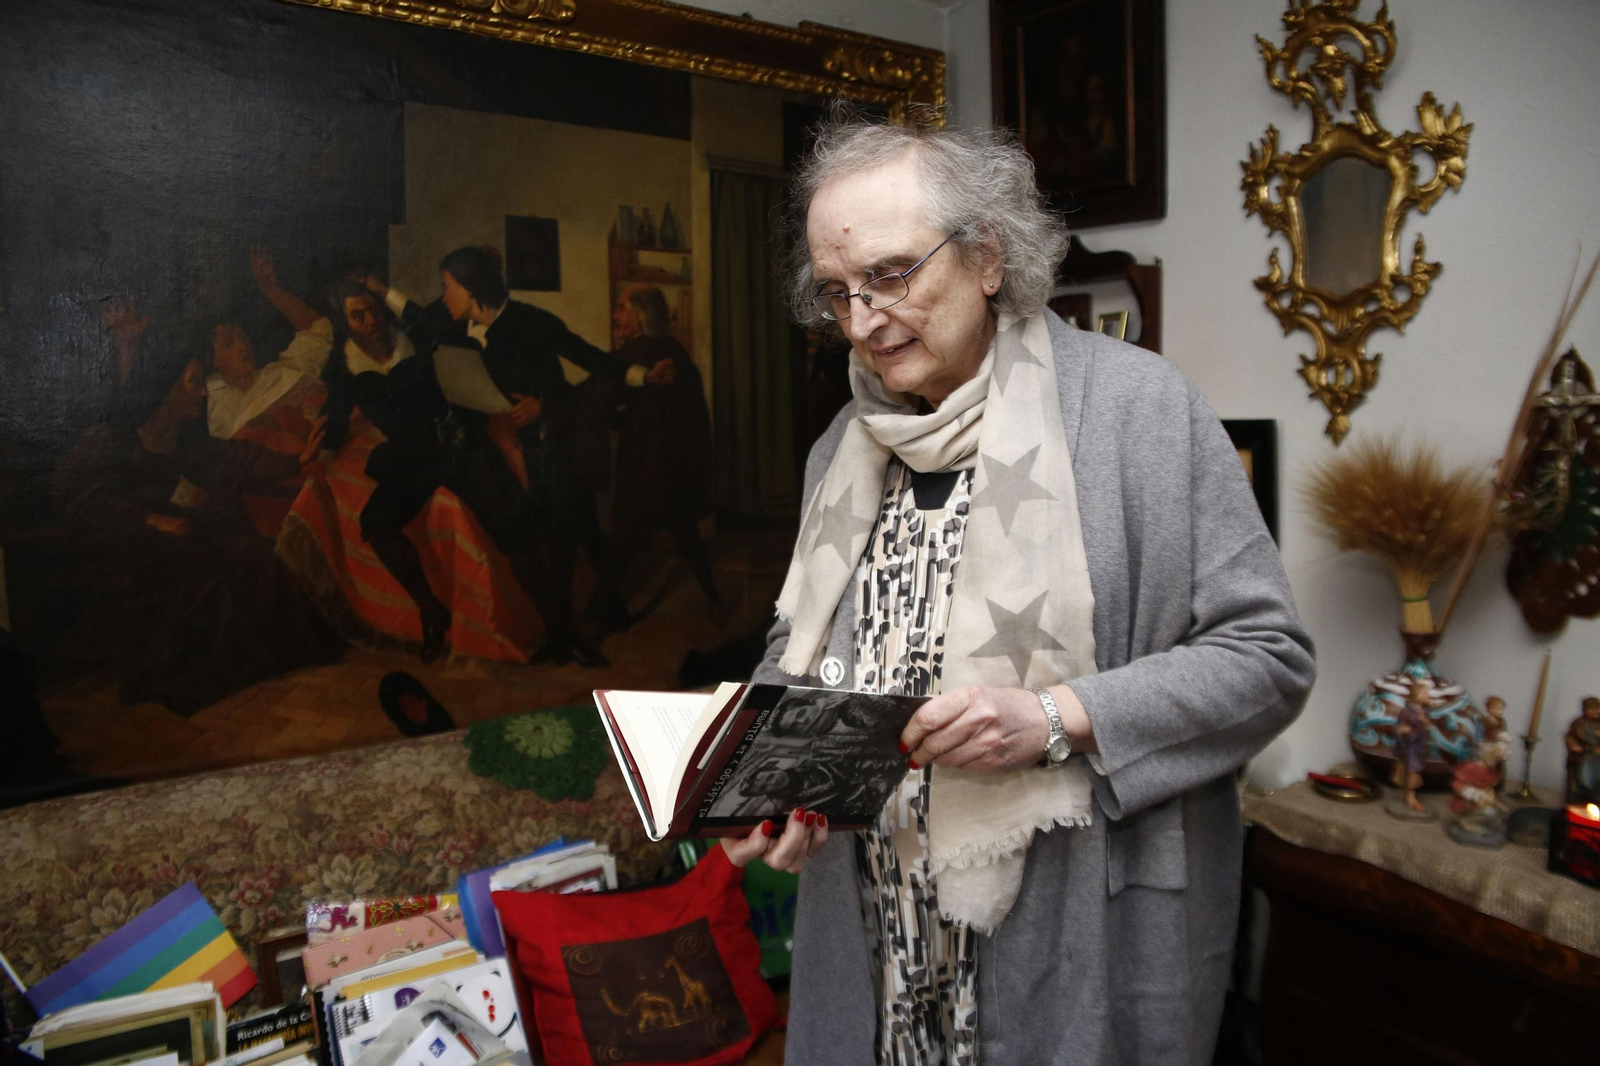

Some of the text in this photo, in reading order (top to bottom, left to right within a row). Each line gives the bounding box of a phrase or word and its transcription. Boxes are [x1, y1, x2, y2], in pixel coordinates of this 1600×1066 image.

[699, 807, 709, 818] el
[704, 768, 732, 803] látigo
[736, 745, 747, 756] la
[745, 709, 770, 741] pluma
[237, 1024, 274, 1041] Ricardo
[276, 1020, 288, 1030] de
[290, 1015, 299, 1026] la
